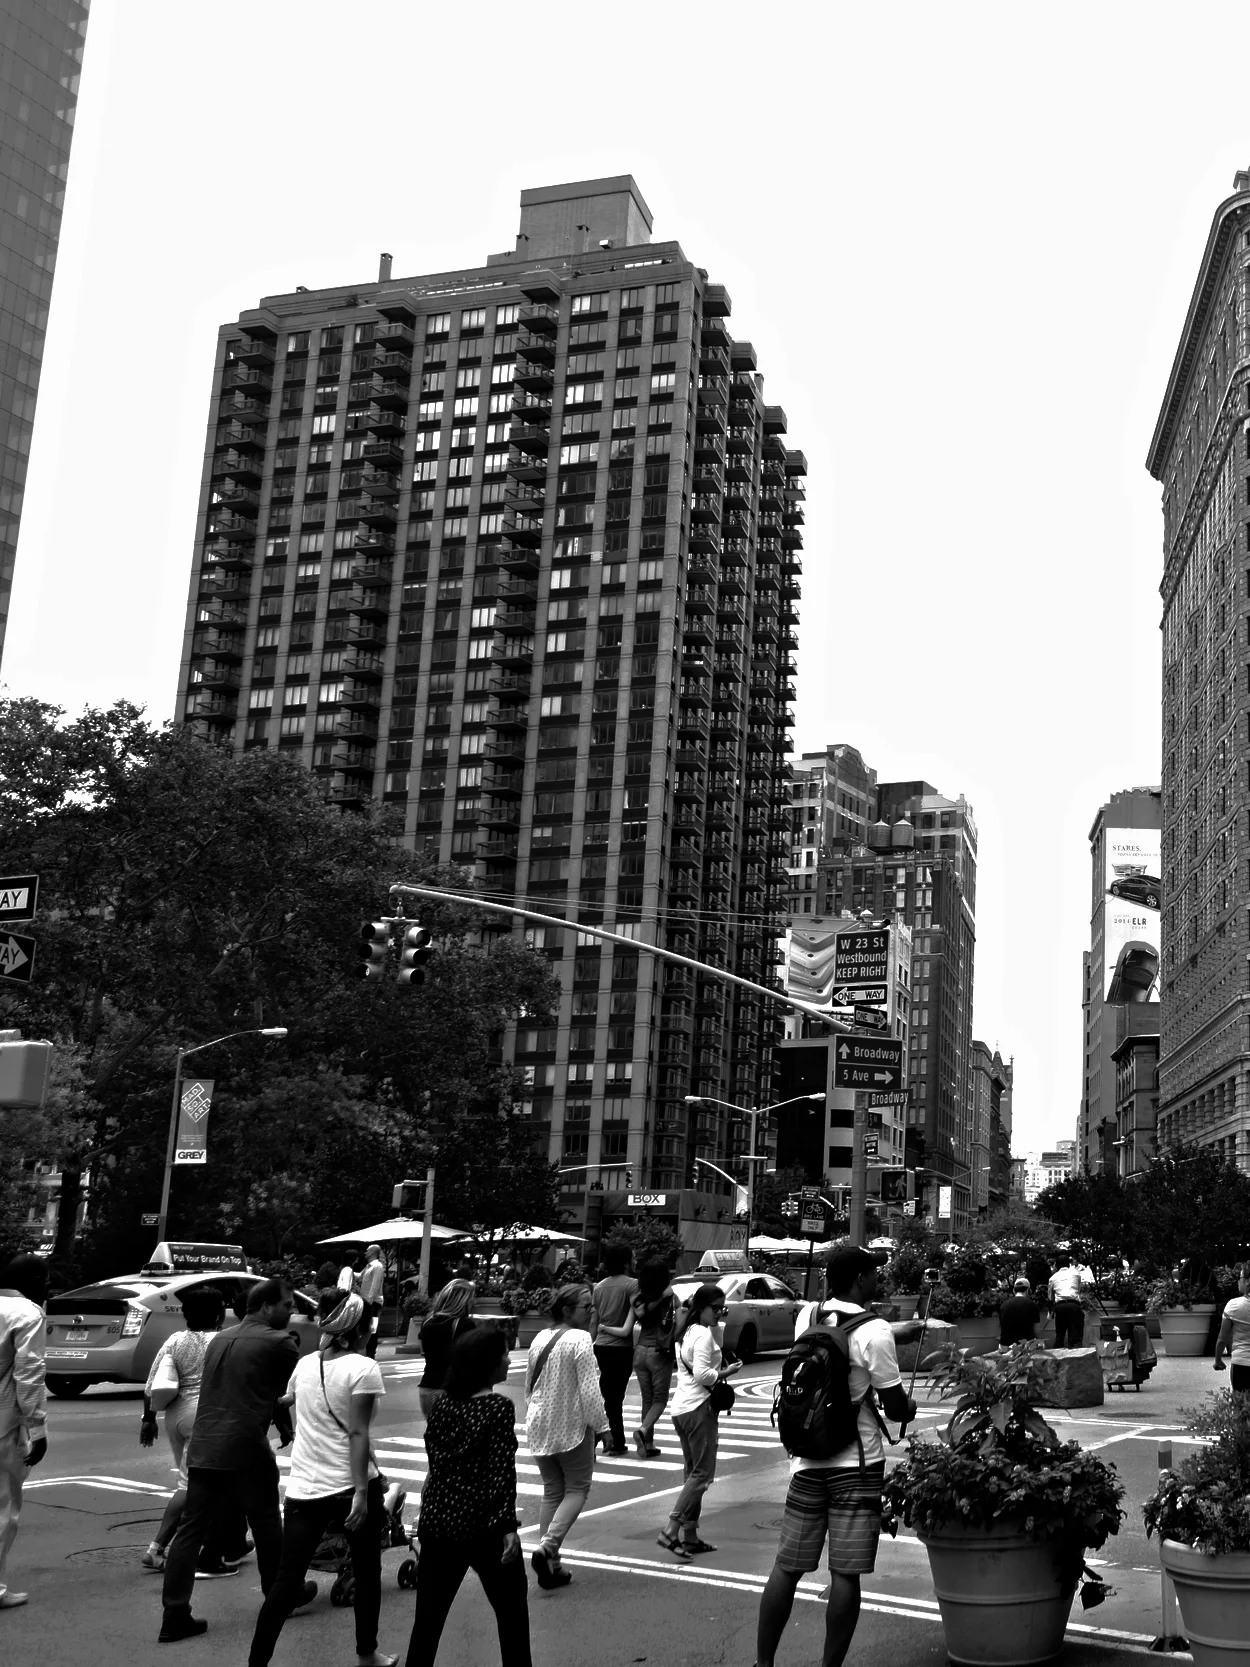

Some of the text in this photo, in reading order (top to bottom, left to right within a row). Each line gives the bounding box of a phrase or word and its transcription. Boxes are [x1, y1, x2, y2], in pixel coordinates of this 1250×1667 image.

[0, 890, 22, 908] AY
[840, 936, 884, 949] W 23 St
[0, 946, 20, 965] AY
[837, 951, 887, 964] Westbound
[836, 966, 886, 978] KEEP RIGHT
[838, 990, 883, 1000] ONE WAY
[857, 1011, 868, 1019] ONE
[854, 1046, 900, 1062] Broadway
[844, 1069, 869, 1081] 5 Ave
[182, 1088, 201, 1104] MAD.
[871, 1092, 908, 1105] Broadway
[186, 1100, 201, 1112] SQ.
[194, 1103, 211, 1119] ART.
[178, 1151, 204, 1160] GREY
[633, 1195, 660, 1203] BOX
[230, 1256, 241, 1265] Top
